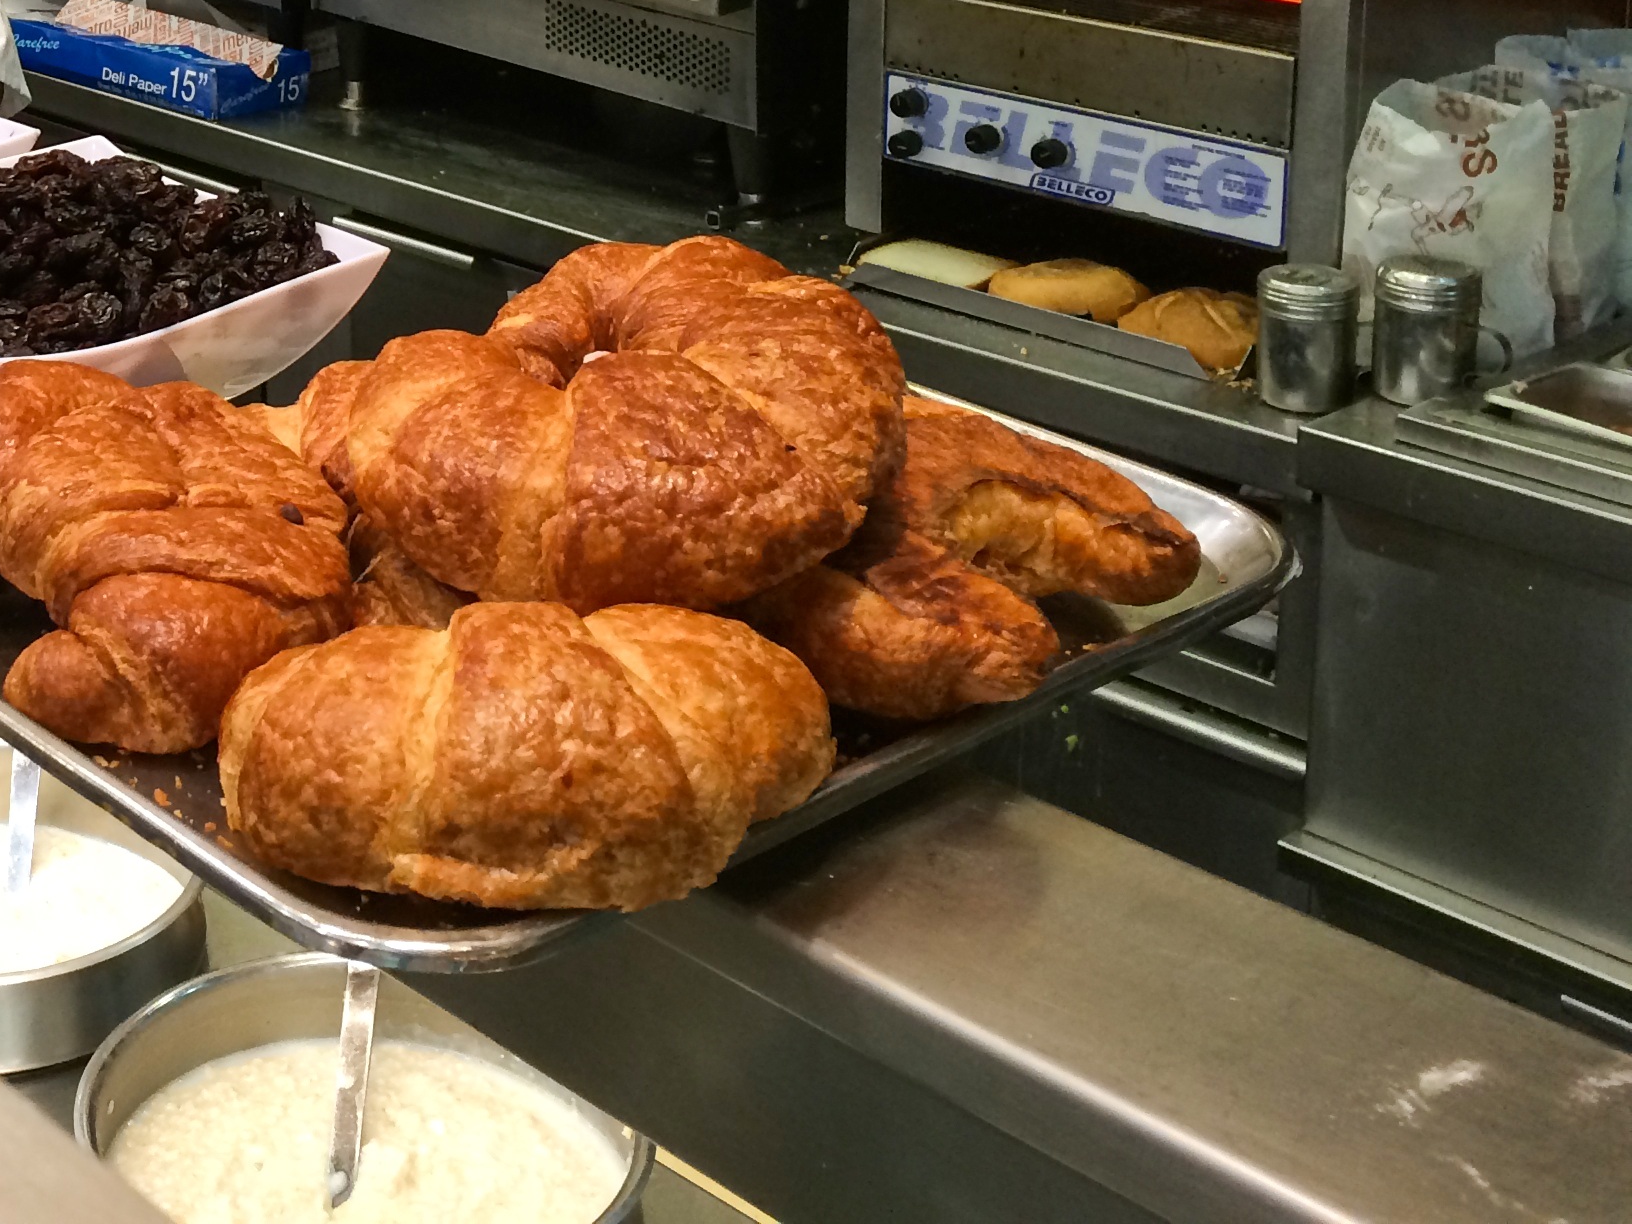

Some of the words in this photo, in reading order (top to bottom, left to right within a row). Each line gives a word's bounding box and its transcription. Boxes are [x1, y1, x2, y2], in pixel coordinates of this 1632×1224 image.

[101, 66, 126, 85] Deli
[129, 73, 167, 95] Paper
[170, 66, 208, 102] 15"
[1035, 178, 1109, 203] BELLECO
